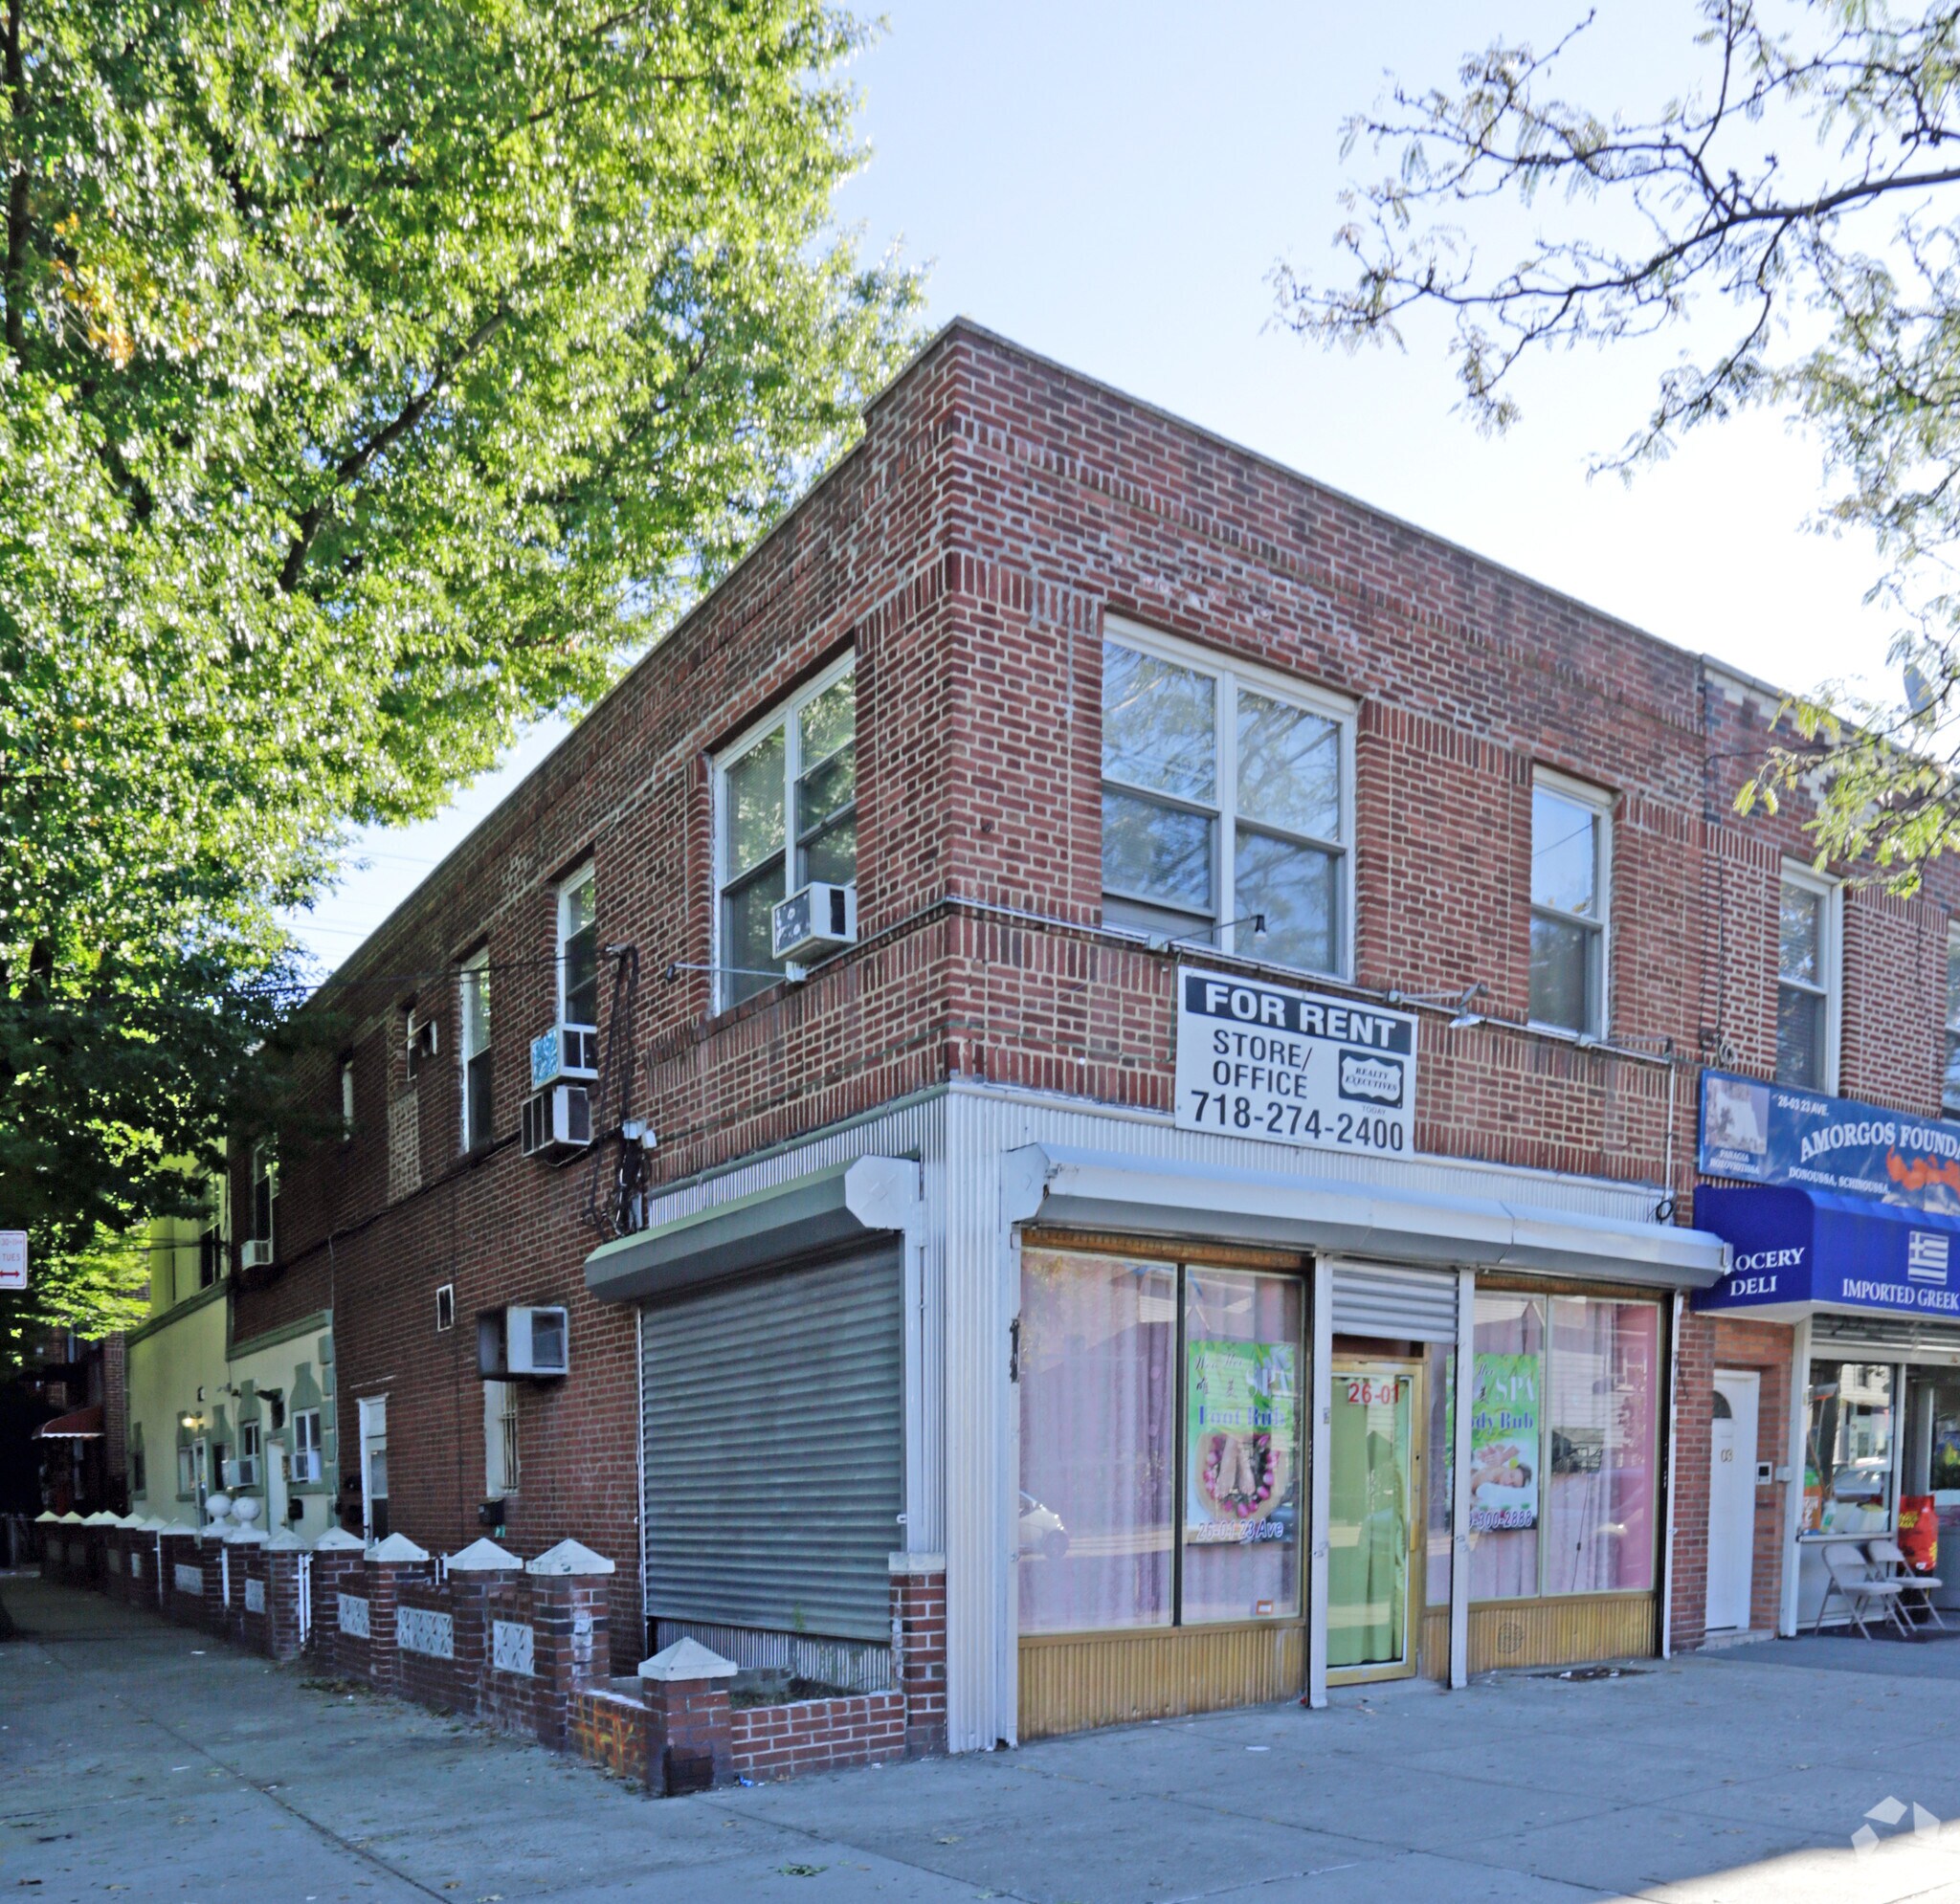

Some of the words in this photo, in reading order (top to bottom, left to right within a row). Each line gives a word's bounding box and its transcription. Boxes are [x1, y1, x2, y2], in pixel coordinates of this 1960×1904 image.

[1205, 982, 1286, 1028] FOR
[1299, 1002, 1396, 1049] RENT
[1213, 1029, 1313, 1072] STORE/
[1213, 1060, 1308, 1099] OFFICE
[1345, 1074, 1398, 1093] EXECUTIVES
[1355, 1067, 1389, 1080] REALTY
[1191, 1089, 1404, 1152] 718-274-2400
[1362, 1104, 1387, 1116] TODAY
[1800, 1121, 1897, 1163] AMORGOS
[2, 1252, 21, 1262] TUES
[1730, 1247, 1806, 1273] OCERY
[1729, 1275, 1778, 1297] DELI
[1842, 1277, 1916, 1306] IMPORTED
[1917, 1288, 1960, 1312] GREEK
[1348, 1382, 1399, 1405] 26-01
[1495, 1376, 1535, 1402] SPA
[1471, 1411, 1494, 1436] ody
[1501, 1411, 1533, 1429] Rub
[1255, 1517, 1284, 1539] Ave
